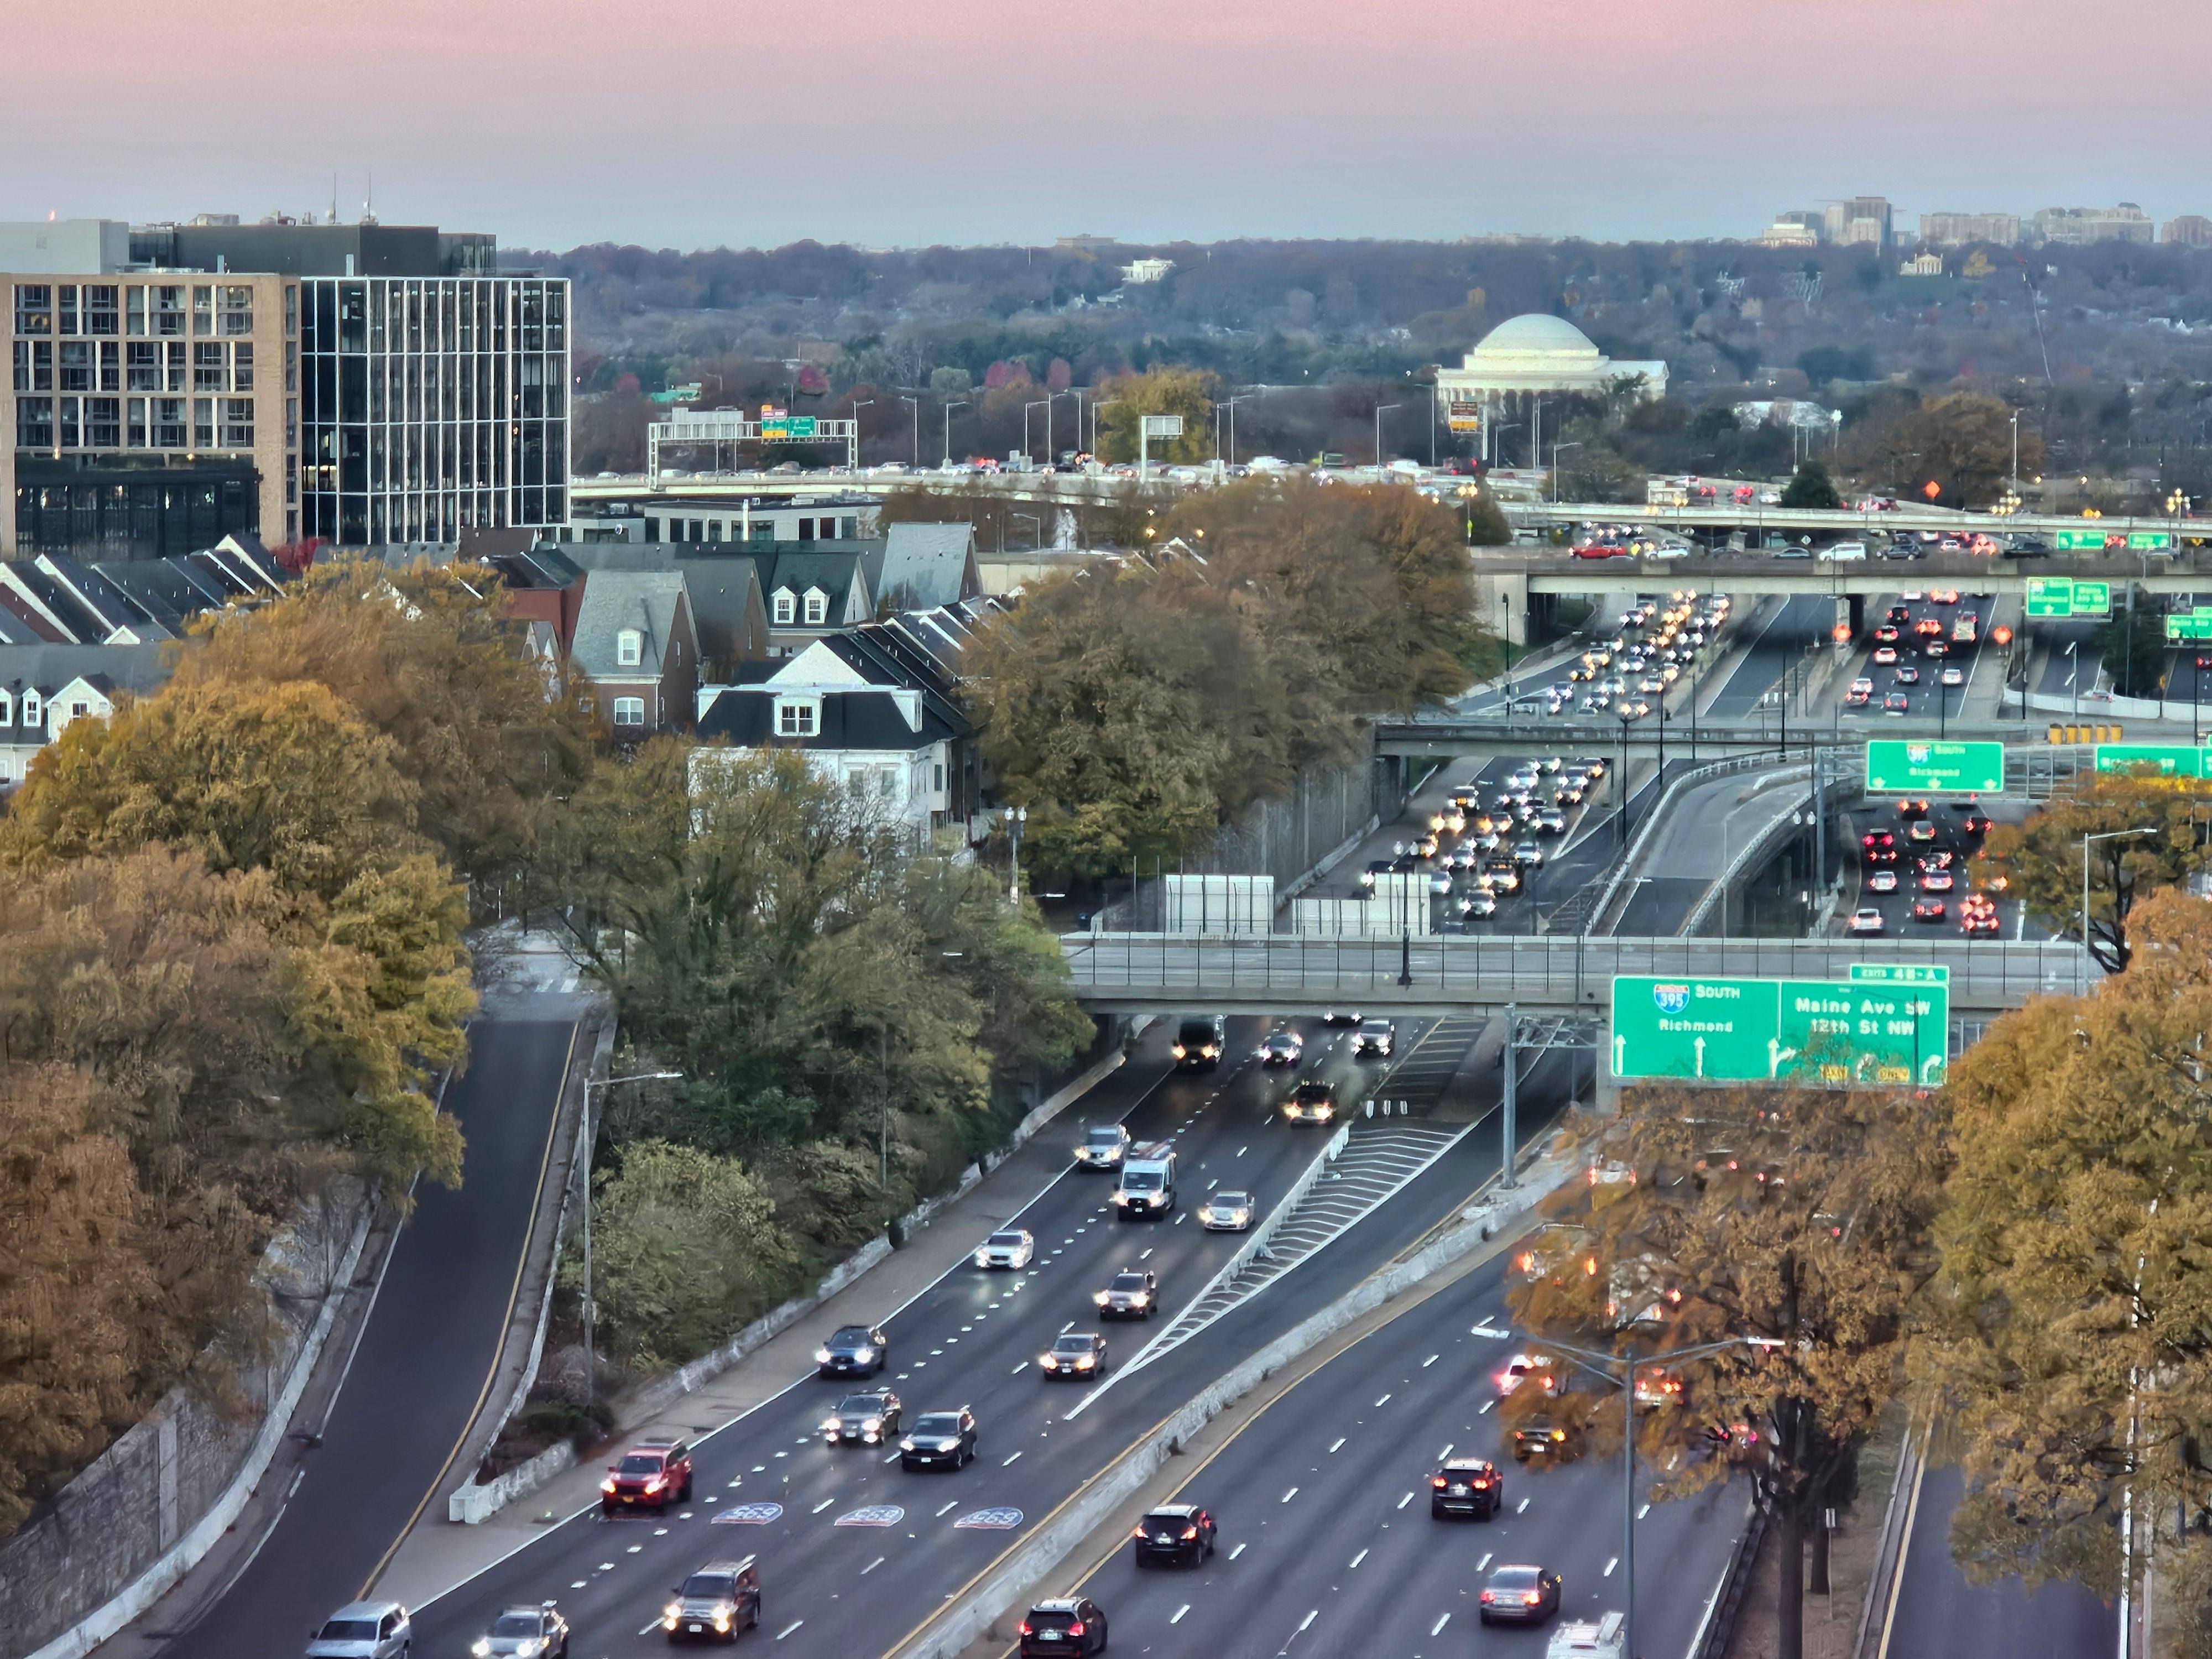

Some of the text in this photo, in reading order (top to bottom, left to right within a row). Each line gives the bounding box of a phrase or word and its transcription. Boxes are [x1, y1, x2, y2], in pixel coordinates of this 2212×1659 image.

[1695, 984, 1741, 999] SOUTH
[1660, 993, 1684, 1008] 395
[1795, 997, 1931, 1016] Maine Ave SW
[1660, 1019, 1733, 1032] Richmond
[1811, 1019, 1915, 1036] 12th St NW
